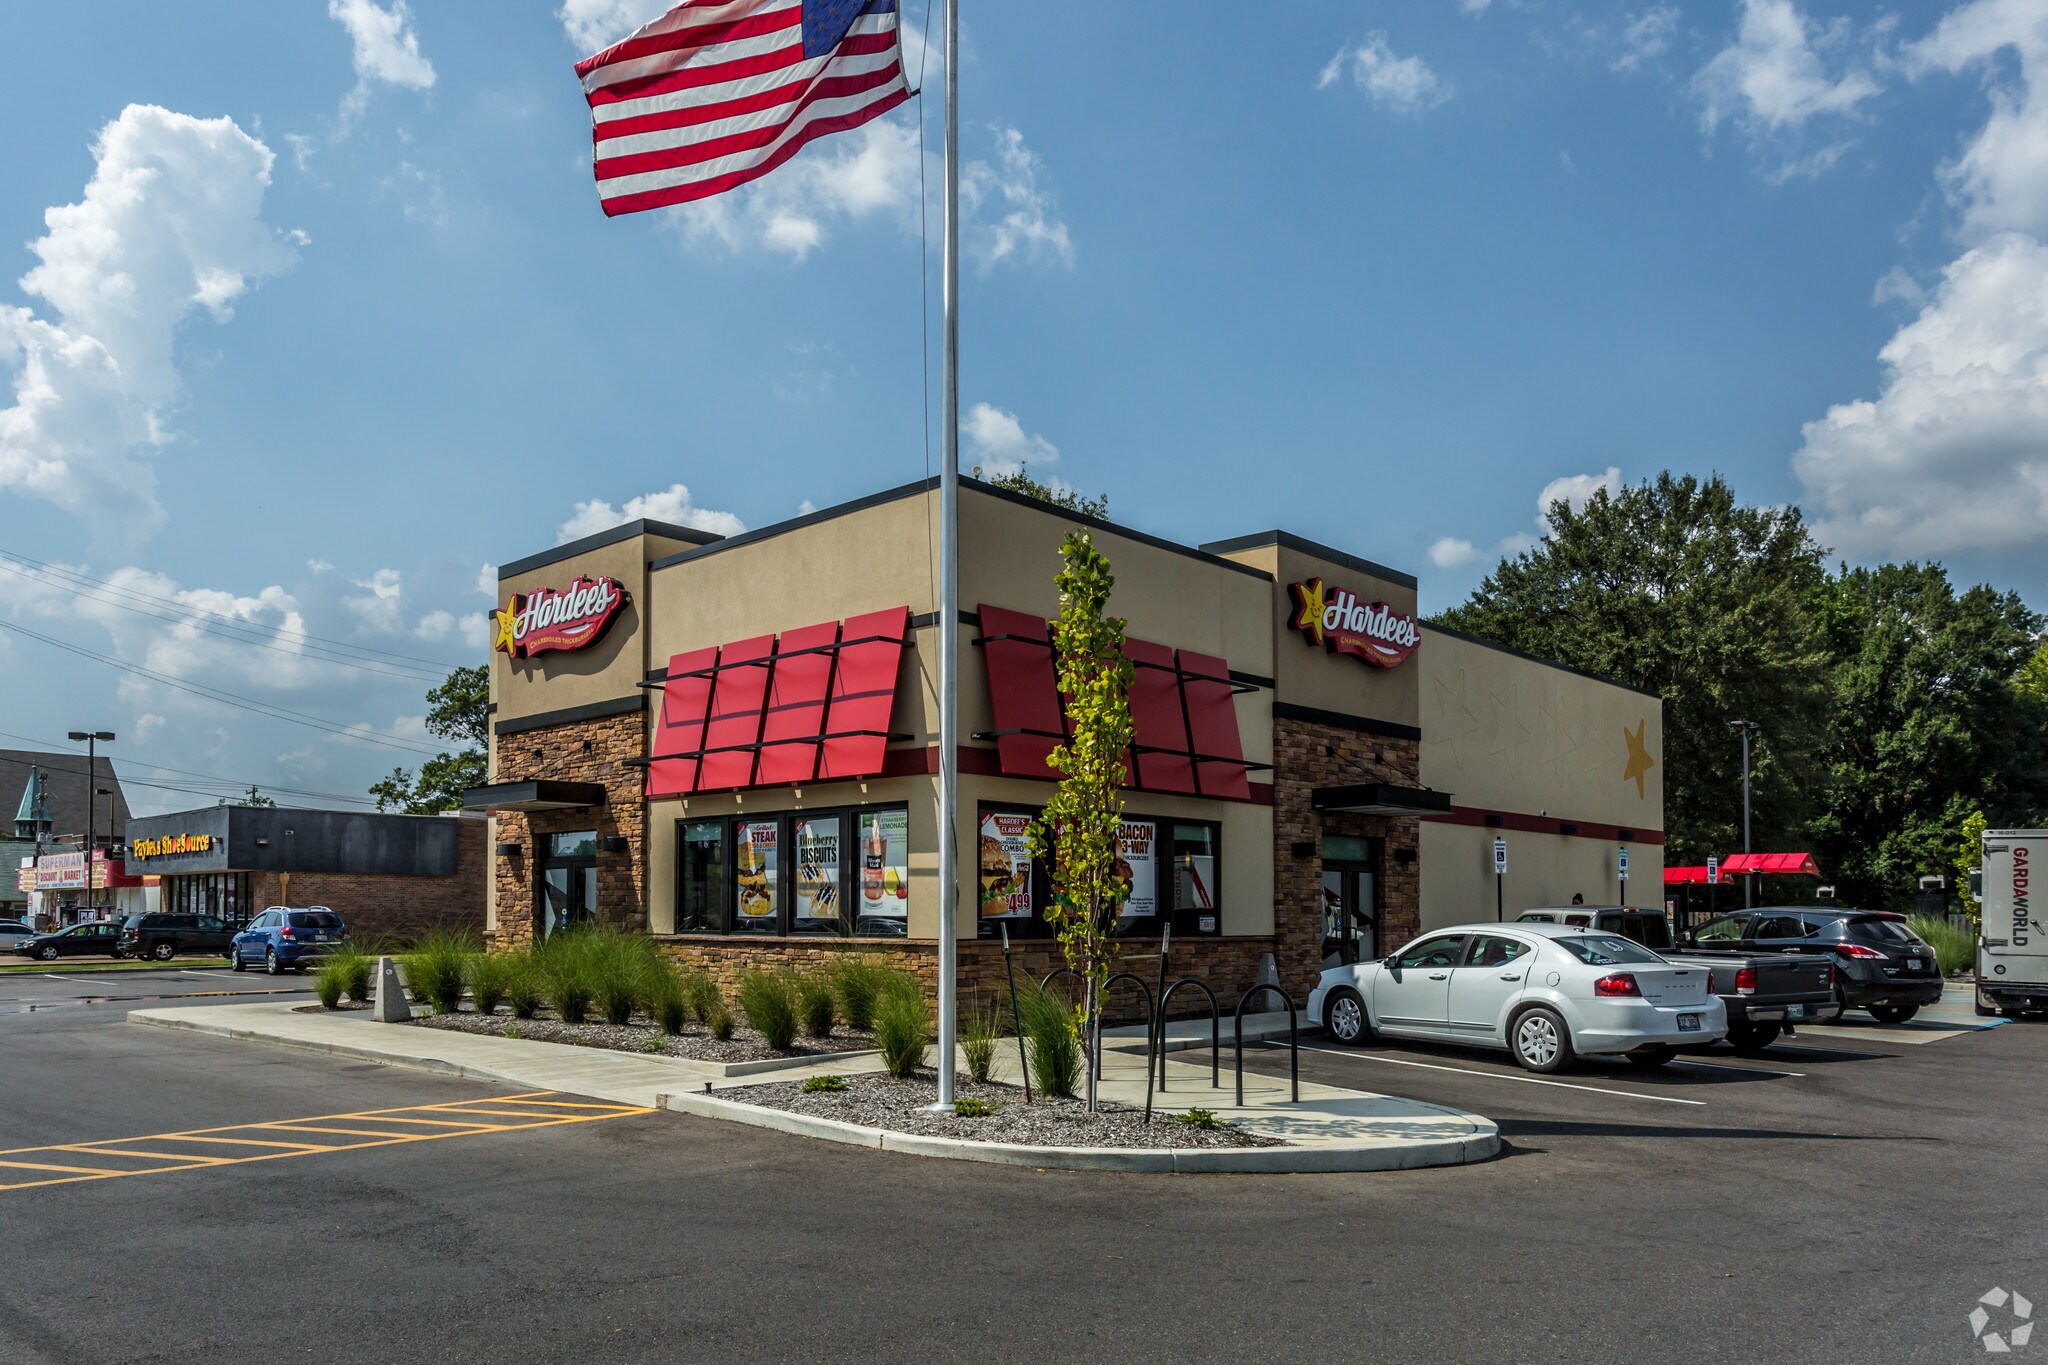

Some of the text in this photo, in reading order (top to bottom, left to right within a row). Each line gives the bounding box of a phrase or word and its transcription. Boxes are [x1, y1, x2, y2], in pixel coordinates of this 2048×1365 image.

[513, 577, 616, 640] Hardee's
[1322, 591, 1420, 647] Hardee's
[529, 636, 561, 649] CHARBROILED
[1340, 636, 1374, 655] CHARBROILED
[999, 817, 1025, 825] HARDEE'S
[751, 831, 776, 843] STEAK
[1001, 826, 1024, 834] CLASSIC
[1118, 824, 1153, 841] BACON
[133, 832, 210, 861] Payless ShoeSource
[799, 833, 838, 848] Blueberry
[1121, 840, 1150, 854] 3-WAY
[800, 847, 837, 863] BISCUITS
[1000, 845, 1024, 853] COMBO
[40, 854, 82, 869] SUPERMAN
[40, 871, 57, 882] DISCOUNT
[63, 870, 81, 880] MARKET
[2012, 846, 2030, 947] GARDAWORLD
